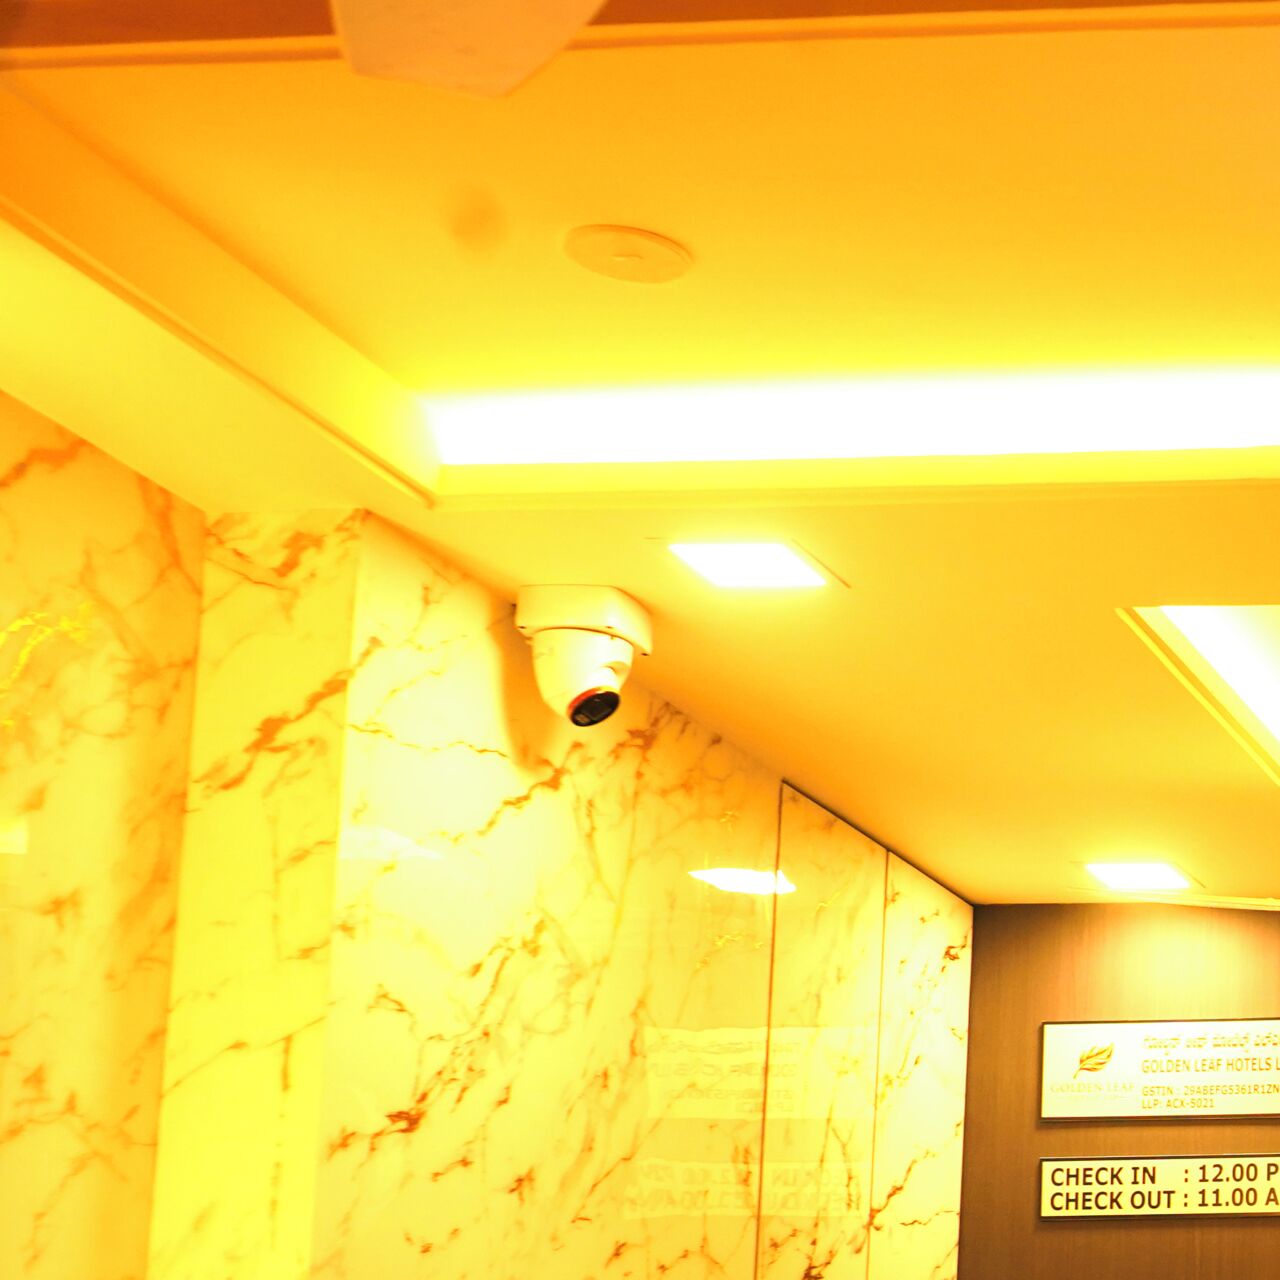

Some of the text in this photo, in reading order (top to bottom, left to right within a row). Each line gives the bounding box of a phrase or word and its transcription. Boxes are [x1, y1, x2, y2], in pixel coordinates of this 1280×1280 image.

[1141, 1059, 1190, 1073] GOLDEN
[1194, 1058, 1223, 1072] LEAF
[1226, 1057, 1271, 1072] HOTELS
[1142, 1085, 1174, 1097] GSTIN
[1050, 1167, 1124, 1186] CHECK
[1131, 1166, 1156, 1185] IN
[1198, 1163, 1258, 1183] 12.00
[1050, 1191, 1123, 1211] CHECK
[1131, 1190, 1176, 1209] OUT
[1198, 1188, 1258, 1207] 11.00
